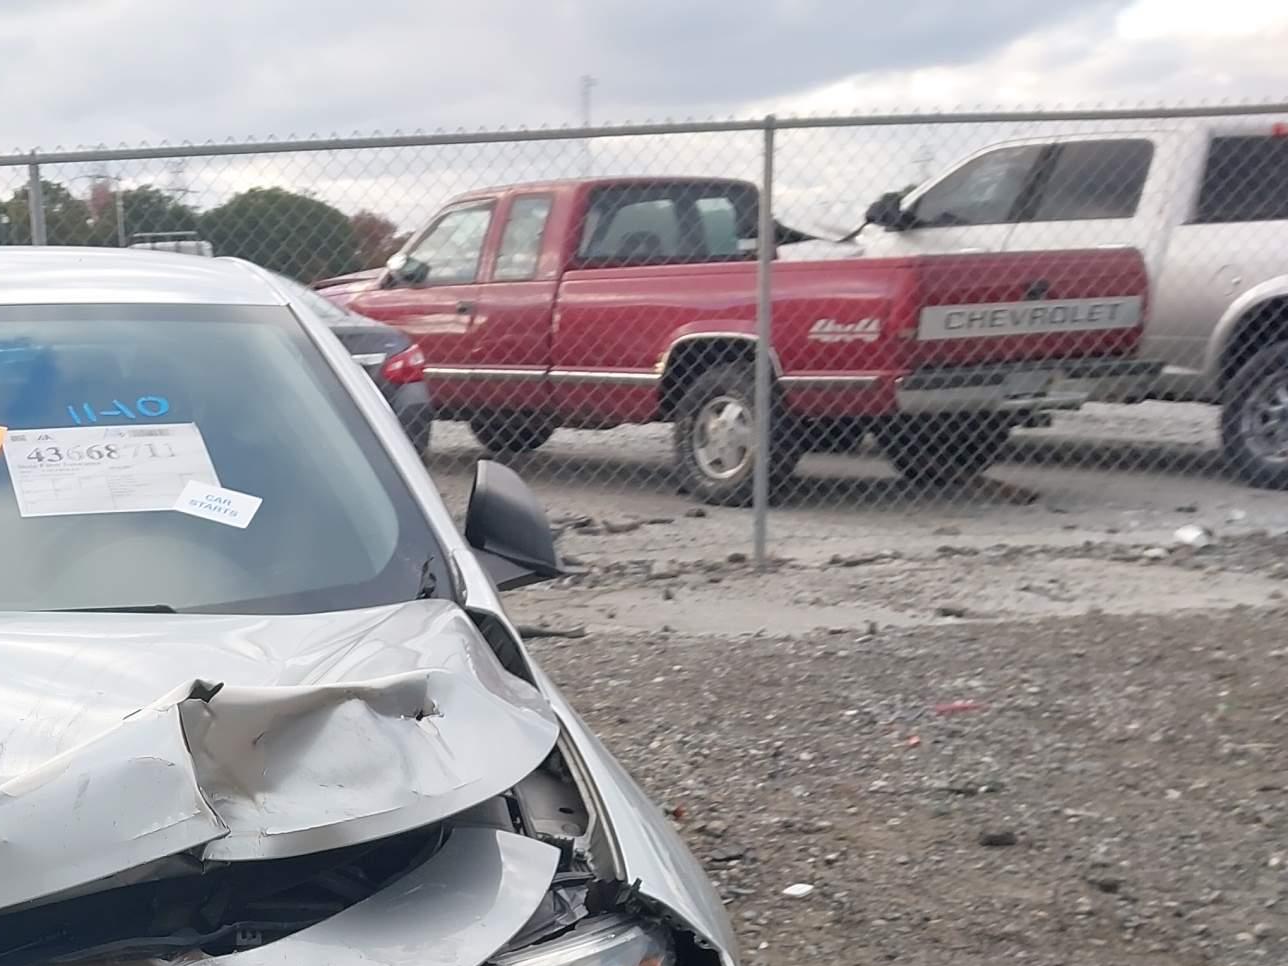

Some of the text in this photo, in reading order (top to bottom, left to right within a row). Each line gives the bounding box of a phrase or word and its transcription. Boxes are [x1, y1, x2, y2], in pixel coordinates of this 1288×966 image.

[943, 302, 1125, 331] CHEVROLET
[807, 317, 882, 343] 4x4
[25, 442, 178, 463] 43668711
[187, 498, 240, 518] STARTS
[204, 493, 233, 507] CAR
